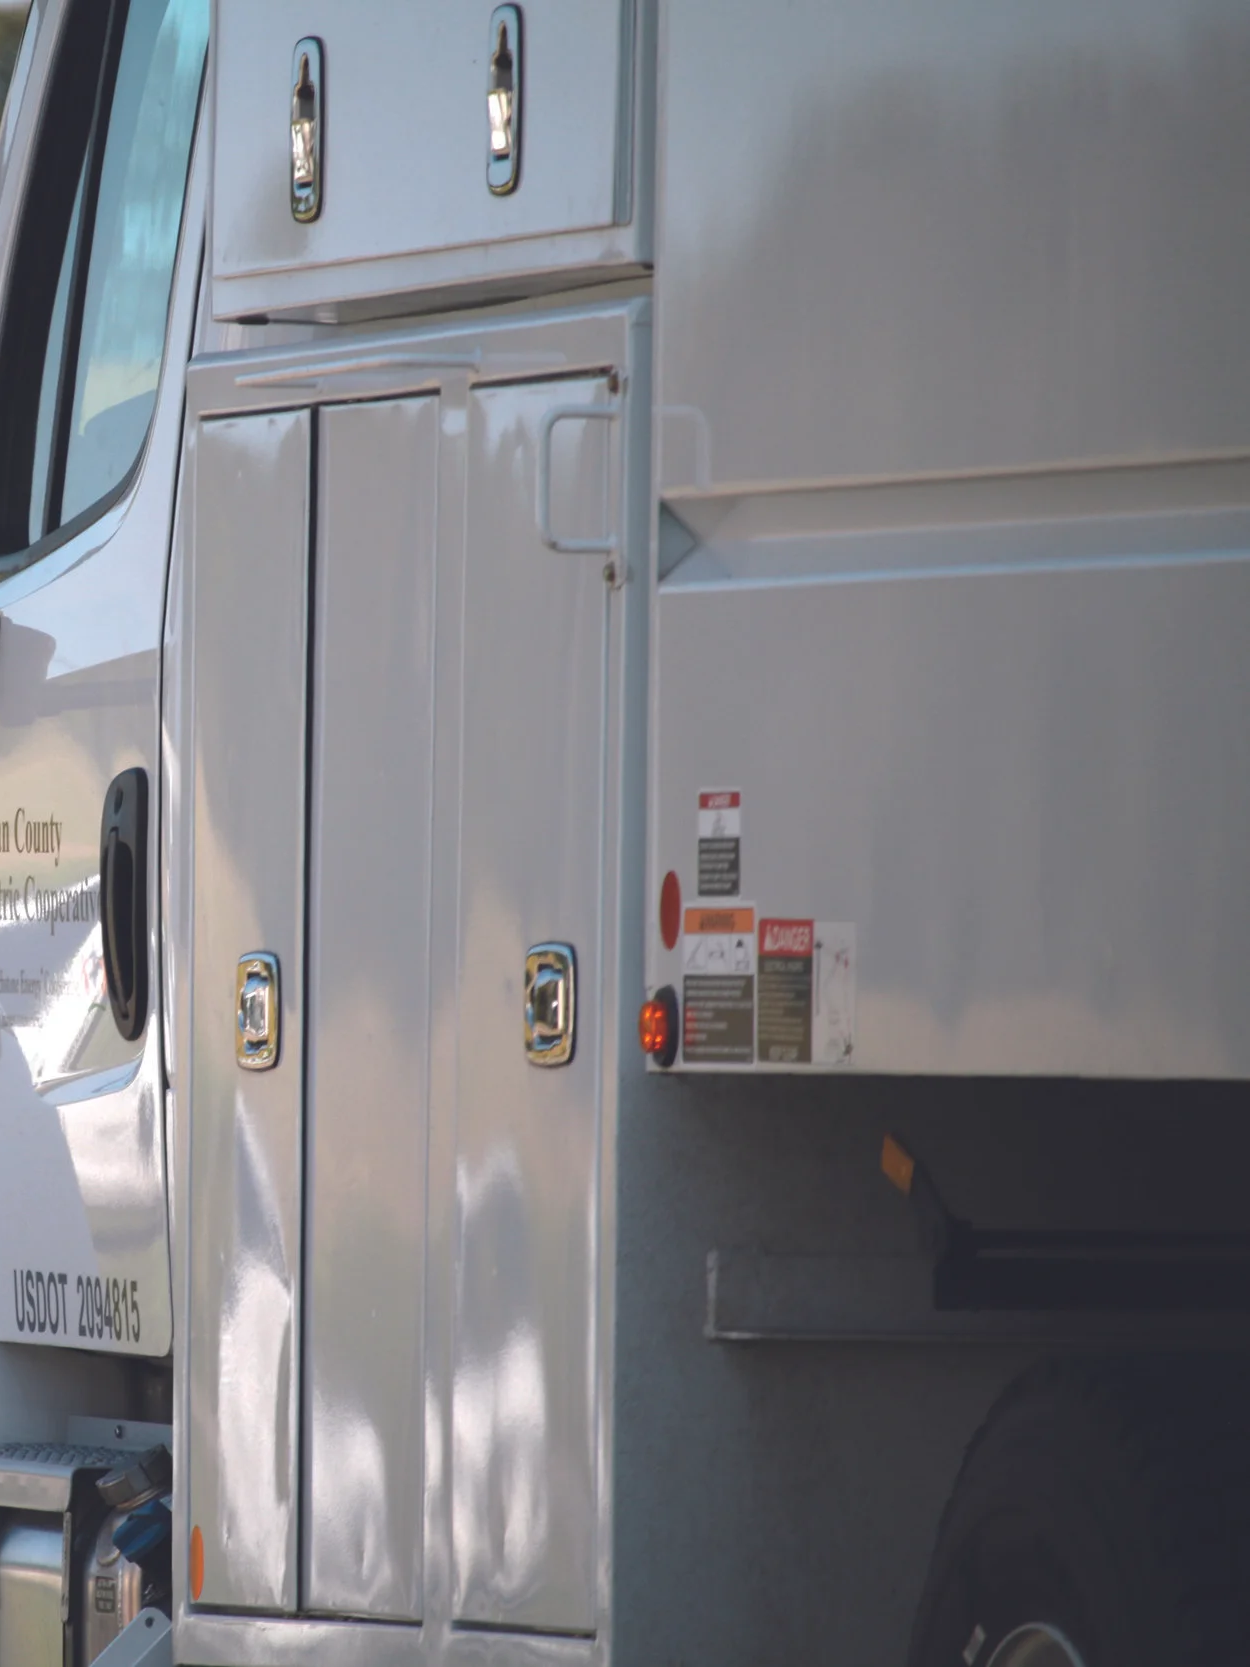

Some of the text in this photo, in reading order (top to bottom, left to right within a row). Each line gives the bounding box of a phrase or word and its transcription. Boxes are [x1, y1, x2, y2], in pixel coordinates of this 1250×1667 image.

[14, 808, 62, 867] County
[23, 875, 101, 936] Cooperativ
[14, 1269, 140, 1343] USDOT 2094815
